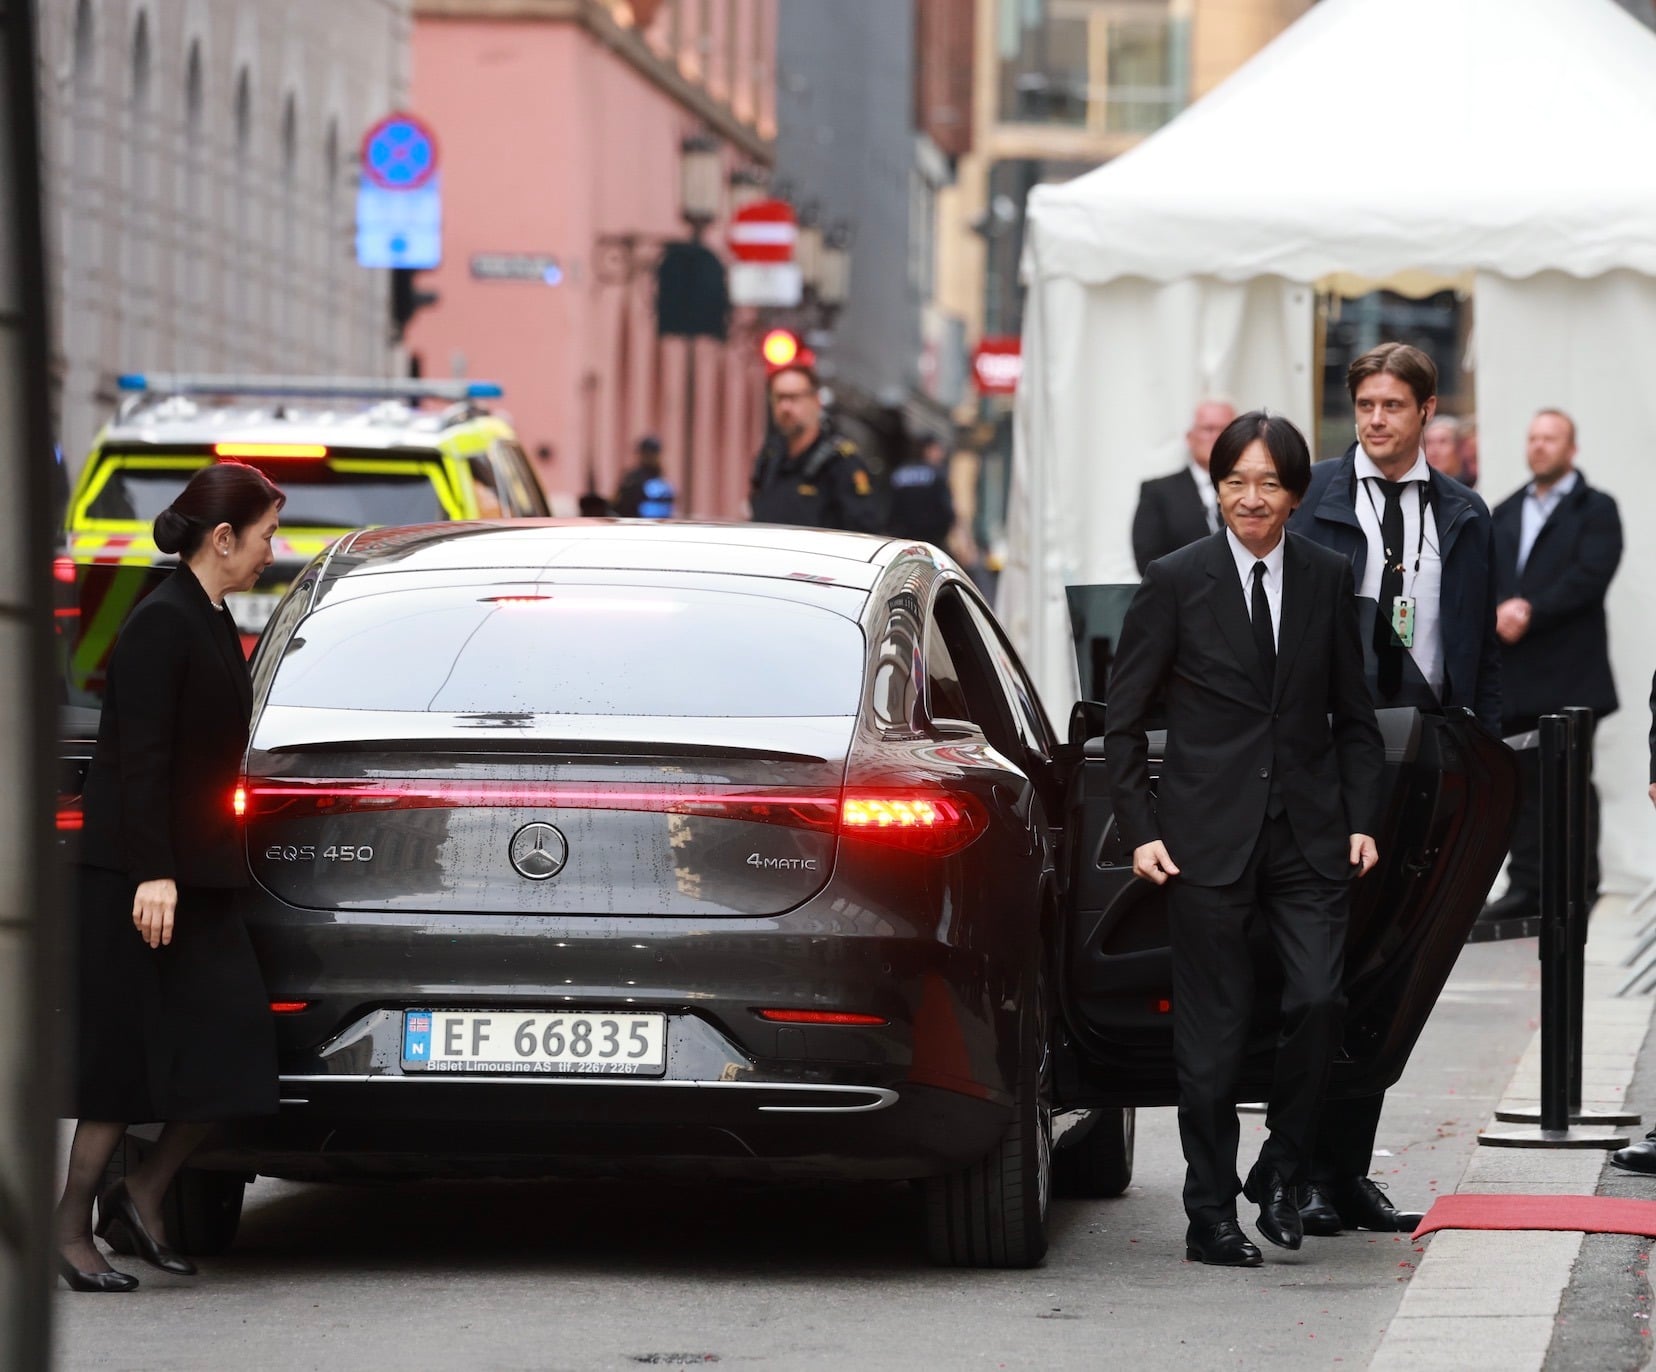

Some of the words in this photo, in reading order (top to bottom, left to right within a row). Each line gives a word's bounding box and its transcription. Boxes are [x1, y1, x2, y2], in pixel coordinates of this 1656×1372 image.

[265, 845, 316, 861] EQS
[323, 845, 375, 862] 450
[746, 852, 817, 870] 4MATIC
[444, 1018, 492, 1056] EF
[513, 1018, 649, 1058] 66835
[412, 1043, 424, 1055] N
[427, 1060, 463, 1072] Bislet
[465, 1060, 531, 1072] Limousine
[533, 1062, 552, 1073] AS
[558, 1062, 575, 1073] tlf.
[578, 1062, 607, 1073] 2267
[610, 1063, 640, 1074] 2267
